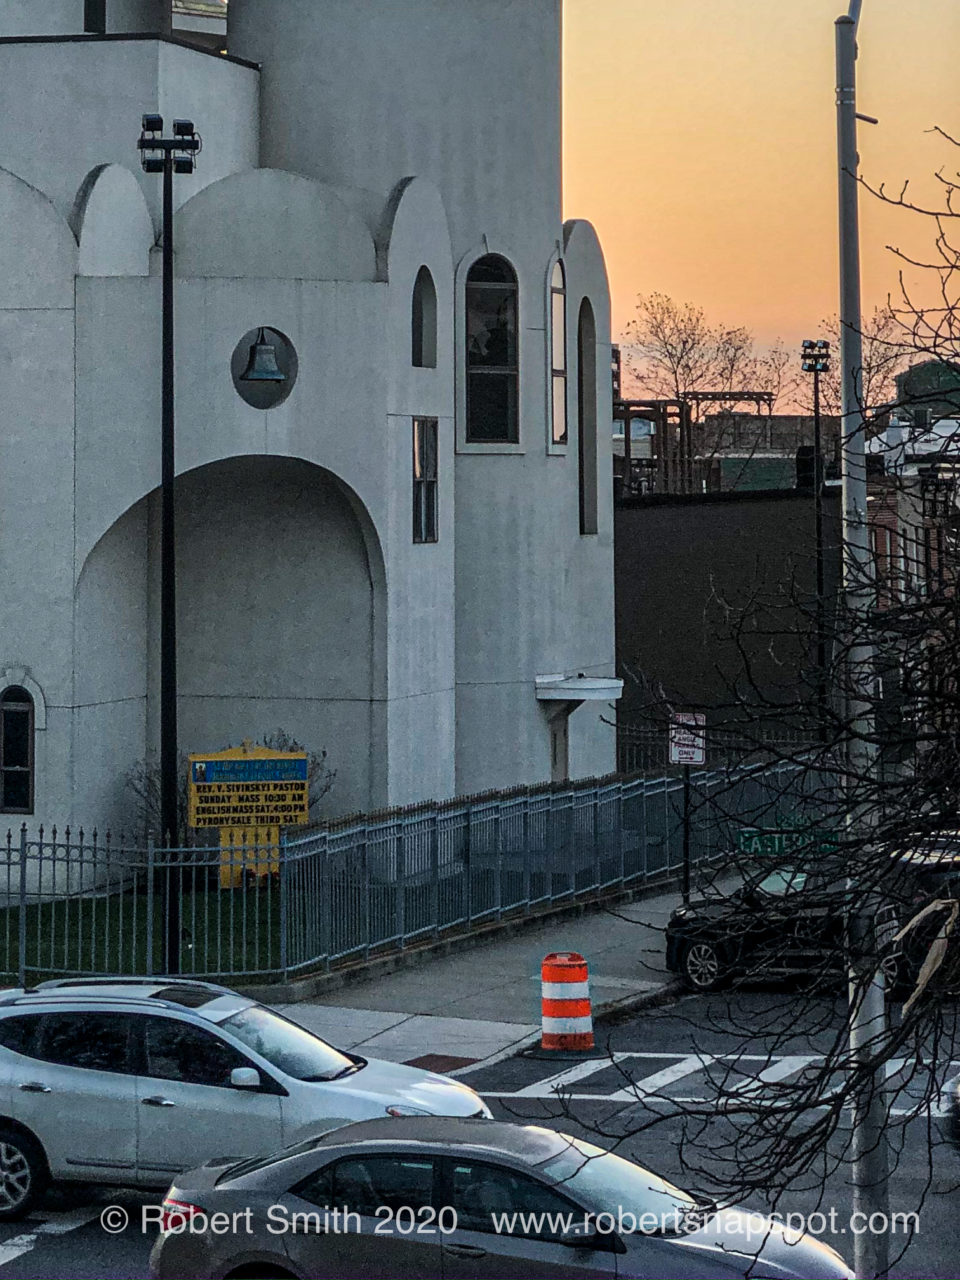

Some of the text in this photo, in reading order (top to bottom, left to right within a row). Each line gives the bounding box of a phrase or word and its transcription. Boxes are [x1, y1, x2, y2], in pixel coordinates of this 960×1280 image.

[196, 784, 215, 793] REV.
[217, 784, 225, 792] V.
[273, 783, 305, 791] PASTOR
[199, 793, 304, 804] SUNDAY MASS 10:30 AM
[196, 805, 231, 815] ENGLISH
[232, 805, 254, 814] MASS
[273, 804, 292, 813] 4:00
[293, 803, 305, 812] PM
[231, 816, 252, 824] SALE
[254, 815, 280, 824] THIRD
